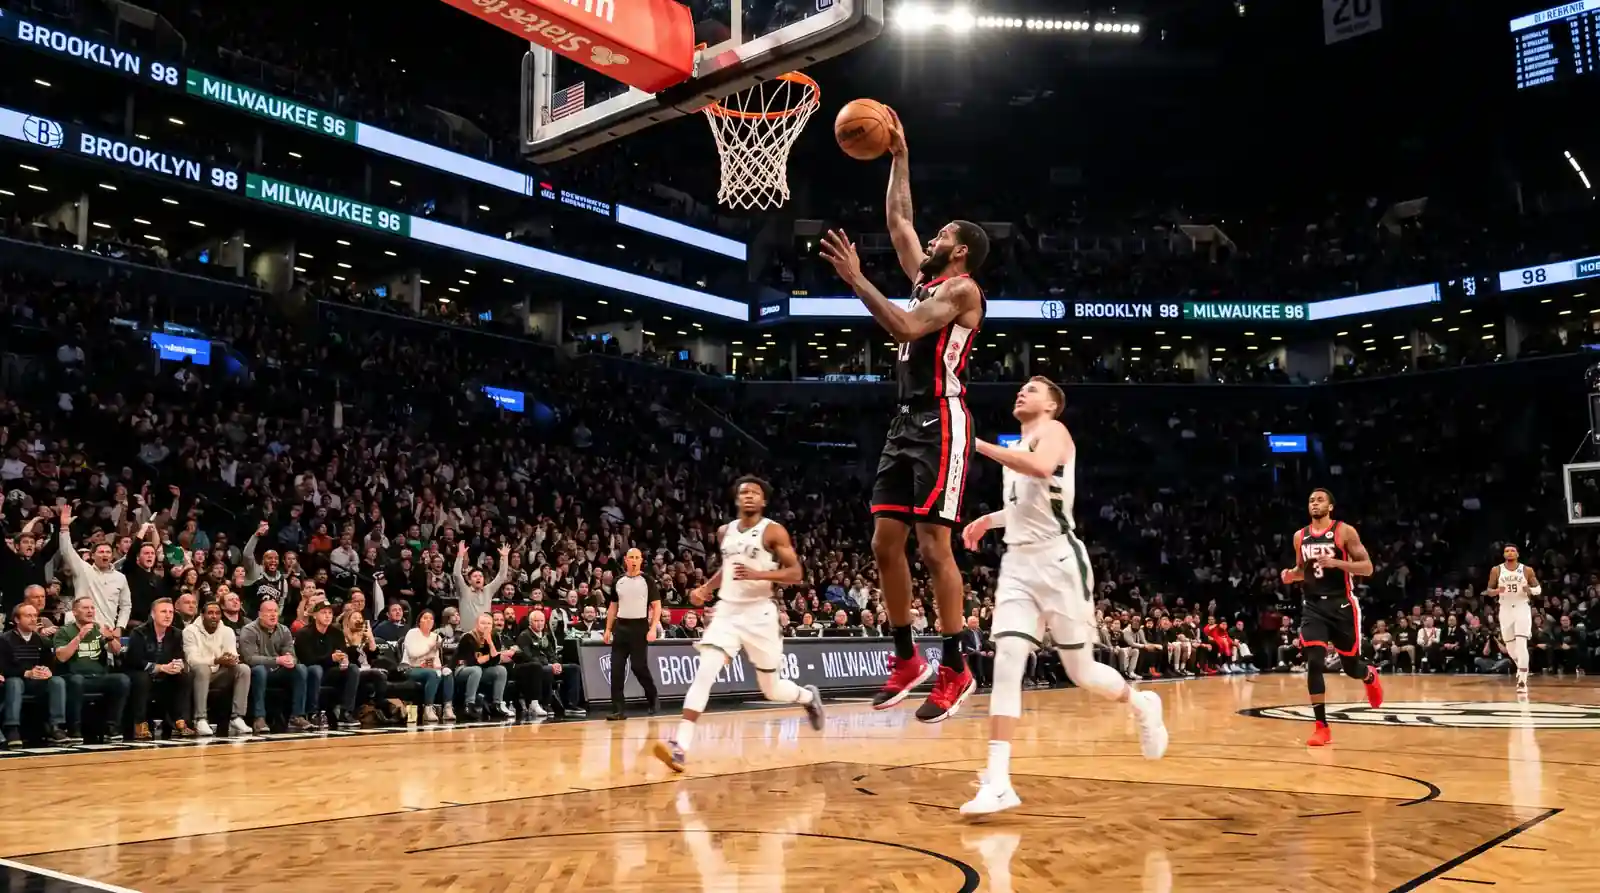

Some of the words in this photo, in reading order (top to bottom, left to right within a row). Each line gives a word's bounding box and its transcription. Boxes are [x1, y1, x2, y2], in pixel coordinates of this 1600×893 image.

[18, 20, 140, 74] BROOKLYN
[151, 62, 178, 85] 98
[203, 77, 318, 129] MILWAUKEE
[323, 115, 346, 136] 96
[81, 133, 200, 181] BROOKLYN
[211, 167, 238, 190] 98
[261, 179, 372, 226] MILWAUKEE
[378, 210, 400, 231] 96
[1522, 268, 1547, 285] 98
[1075, 303, 1152, 318] BROOKLYN
[1159, 304, 1179, 318] 98
[1194, 304, 1280, 319] MILWAUKEE
[1284, 305, 1304, 319] 96
[1301, 543, 1336, 562] NETS
[1312, 562, 1324, 578] 3
[821, 650, 896, 678] MILWAUKE
